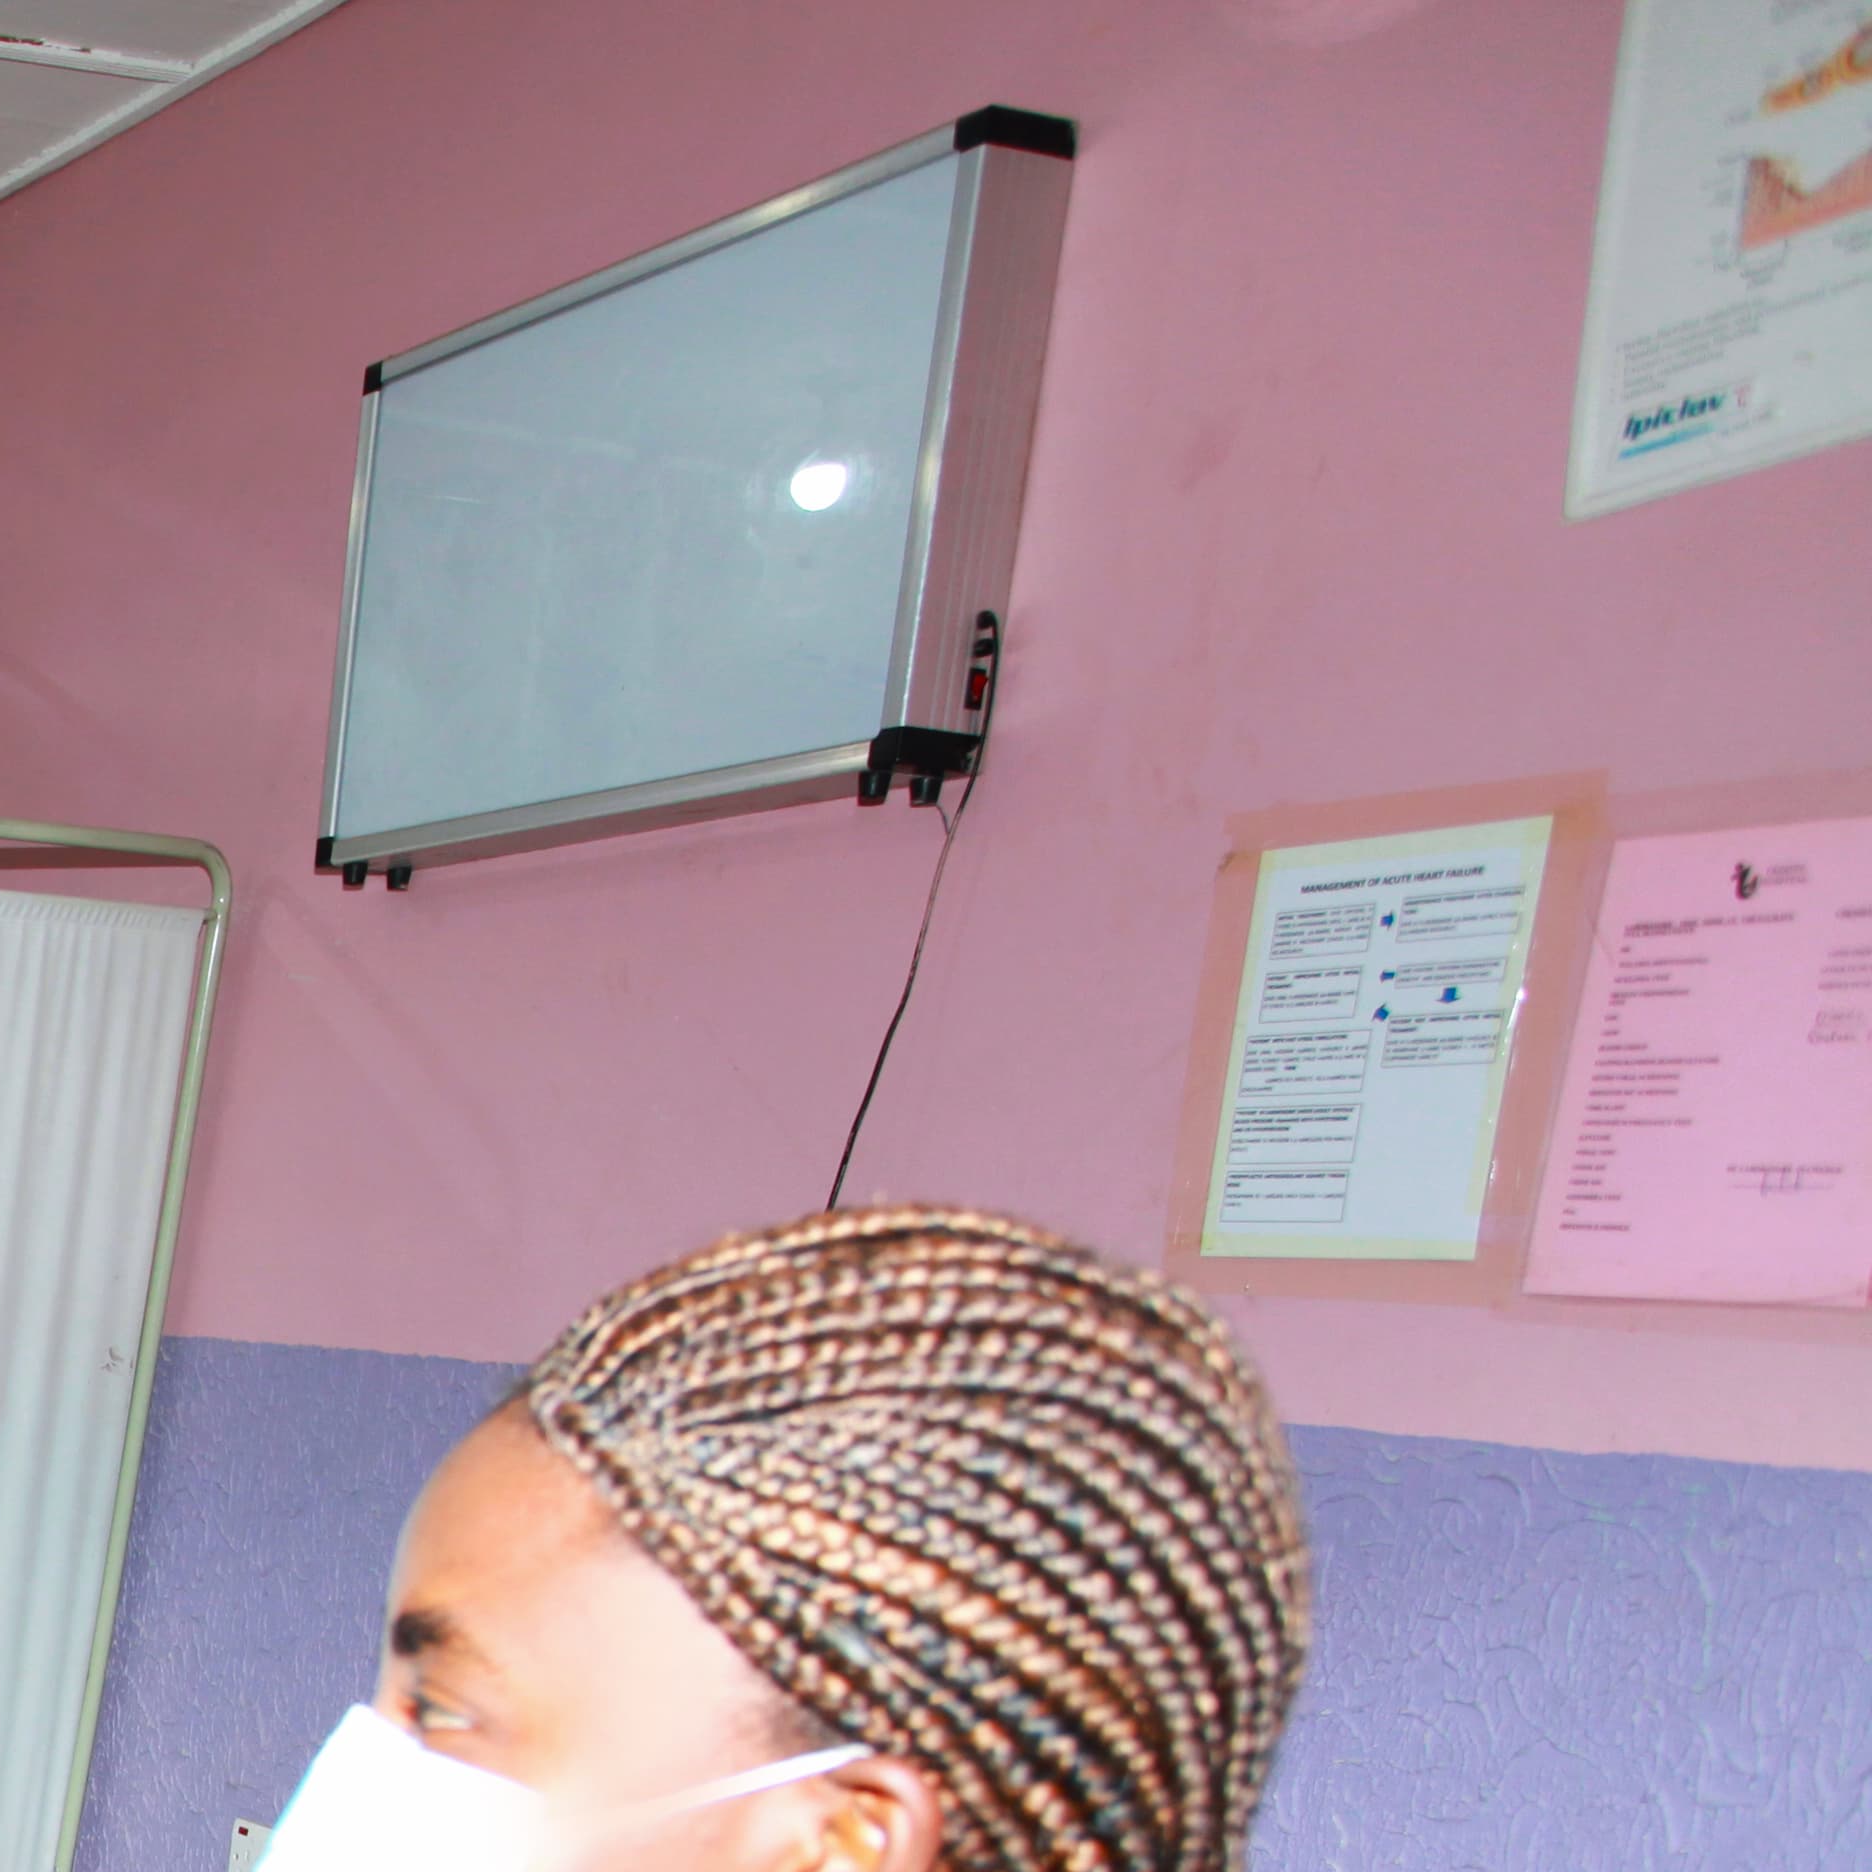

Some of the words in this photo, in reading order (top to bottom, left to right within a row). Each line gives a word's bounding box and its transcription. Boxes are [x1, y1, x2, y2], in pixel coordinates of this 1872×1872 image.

[1301, 879, 1366, 893] MANAGEMENT
[1367, 876, 1381, 888] OF
[1381, 873, 1413, 886] ACUTE
[1413, 869, 1444, 883] HEART
[1445, 866, 1484, 878] FAILURE
